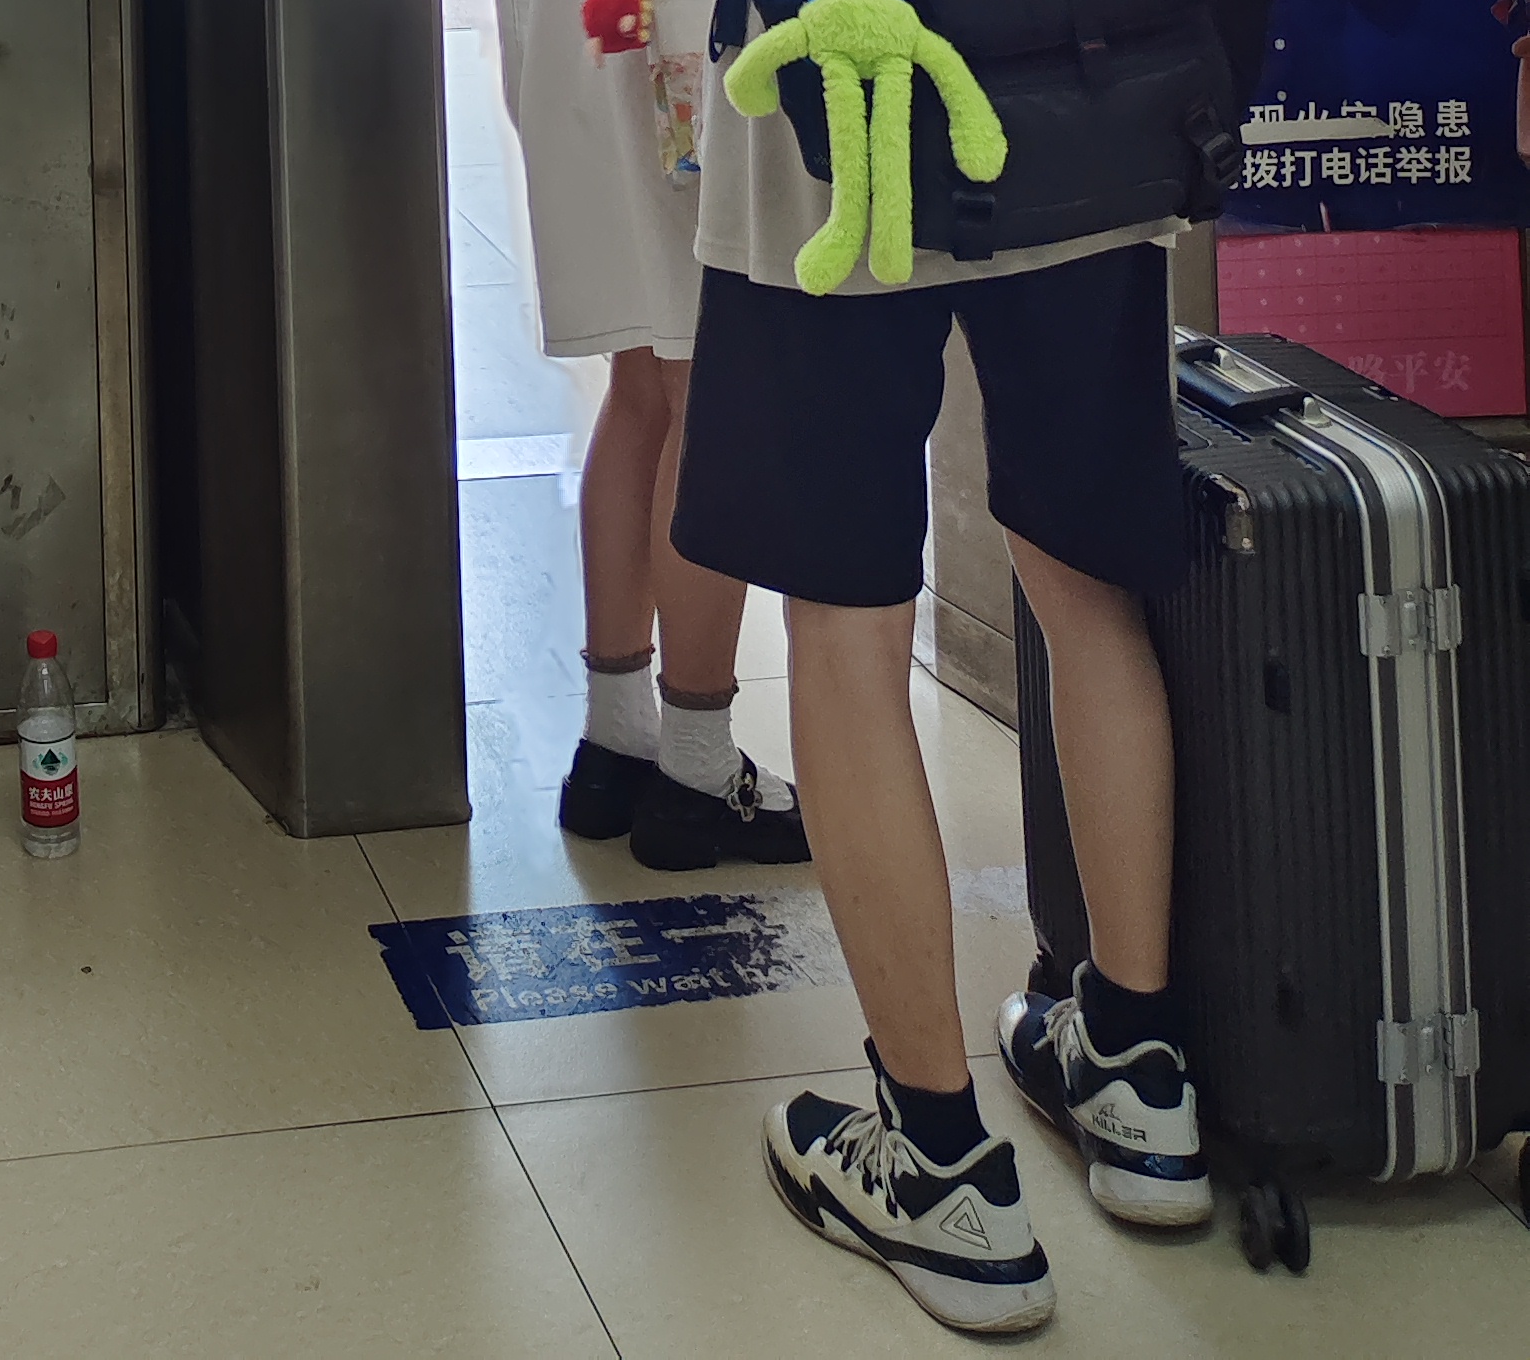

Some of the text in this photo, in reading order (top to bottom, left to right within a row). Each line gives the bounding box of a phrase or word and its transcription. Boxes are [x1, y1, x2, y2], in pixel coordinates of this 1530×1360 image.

[1228, 146, 1472, 190] 拨打电话举报
